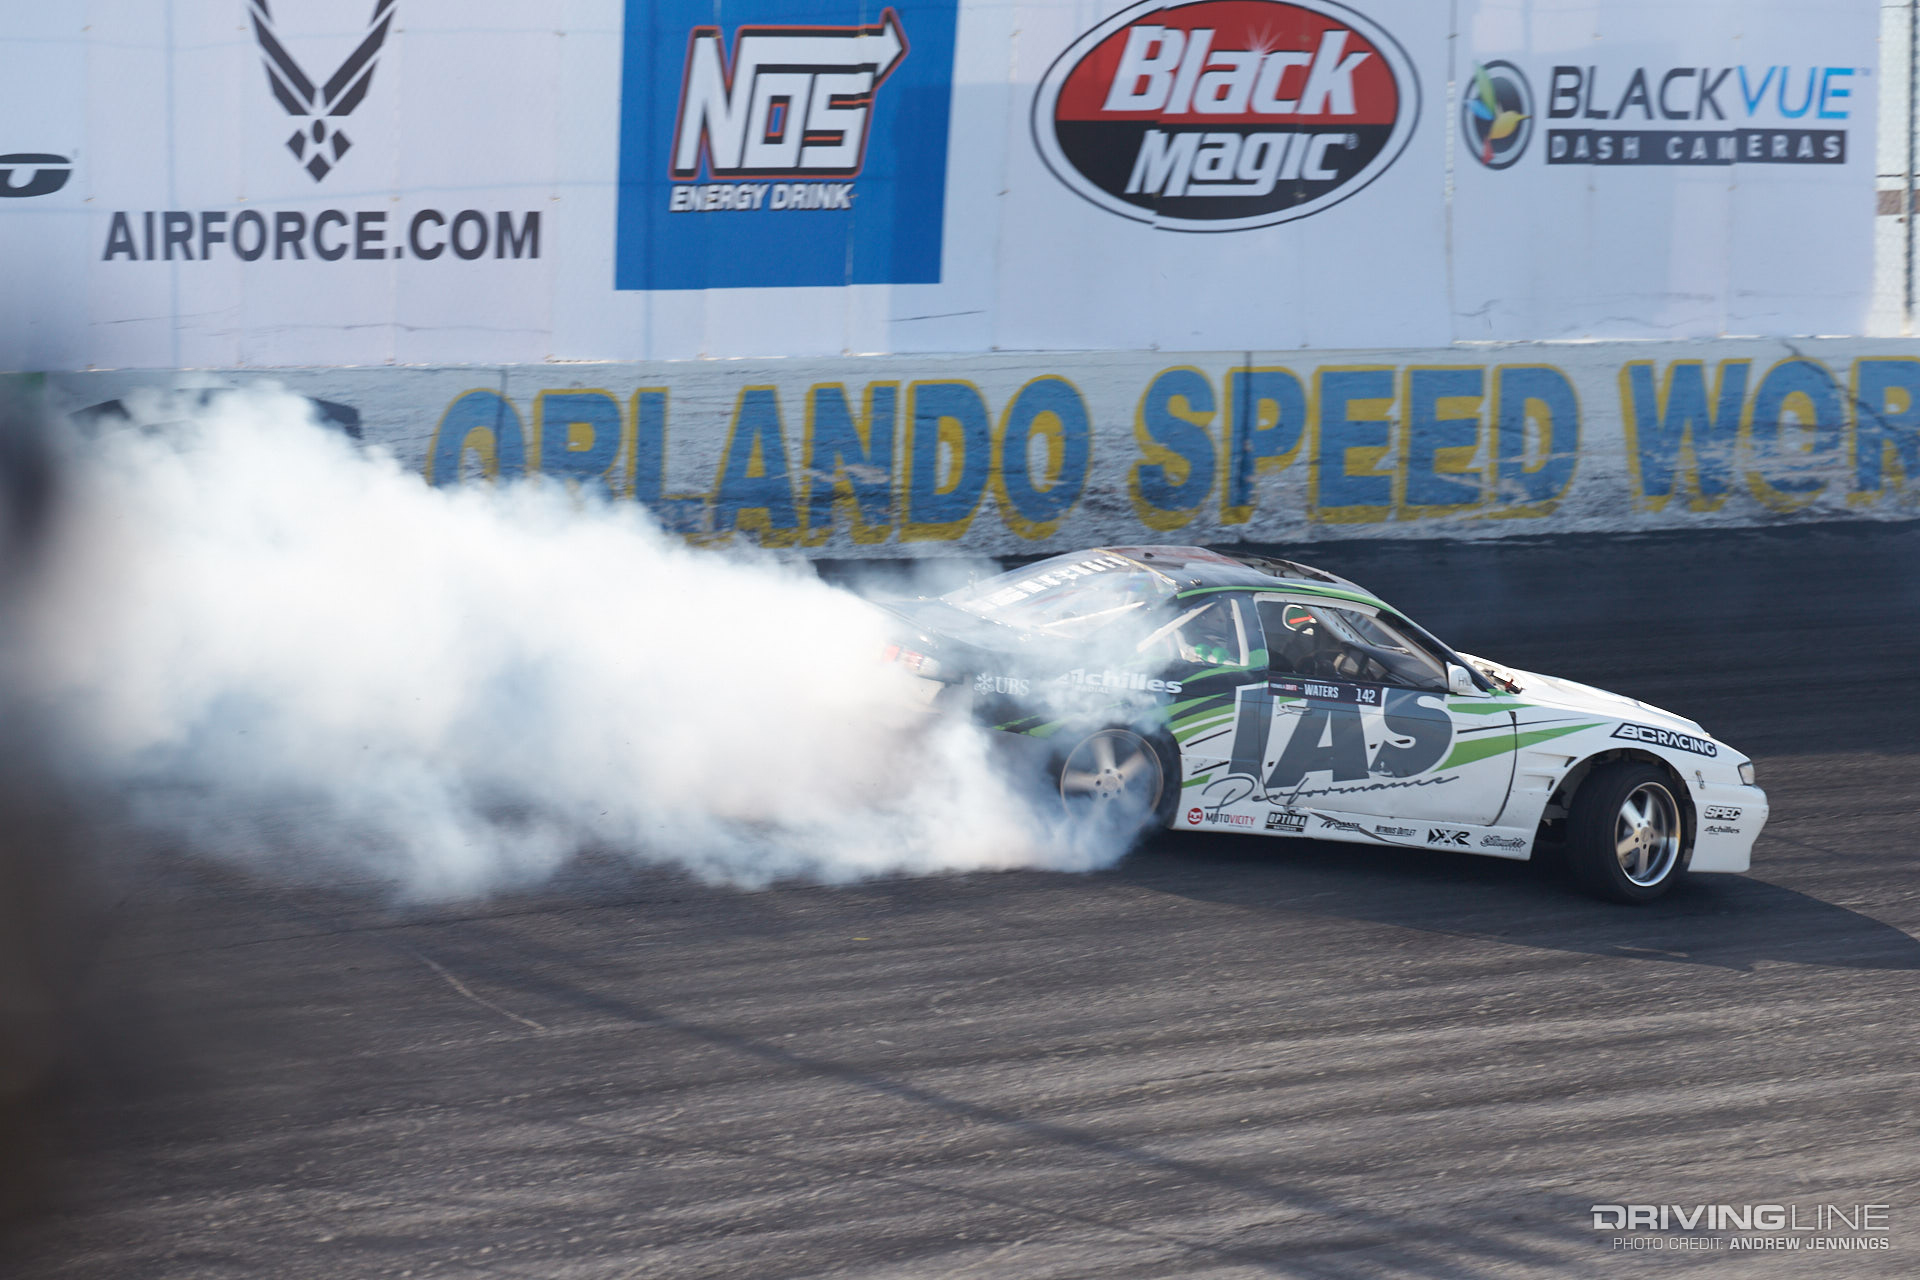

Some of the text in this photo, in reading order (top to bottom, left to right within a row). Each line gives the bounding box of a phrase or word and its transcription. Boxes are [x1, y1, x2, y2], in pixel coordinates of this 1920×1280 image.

[1101, 24, 1373, 116] Black
[669, 10, 908, 180] NOS
[1547, 65, 1855, 121] BLACKVUE
[1552, 134, 1842, 161] DASH CAMERAS
[1124, 128, 1348, 198] Magic
[669, 182, 853, 212] ENERGY DRINK
[103, 209, 541, 262] AIRFORCE.COM
[1131, 363, 1580, 531] SPEED
[995, 676, 1030, 697] UBS
[1051, 667, 1184, 695] Achilles
[1304, 683, 1339, 698] WATERS
[1355, 688, 1376, 703] 142
[1205, 812, 1256, 825] MOTOVICITY
[1268, 813, 1307, 827] OPTIMA
[1704, 806, 1741, 819] SPEC
